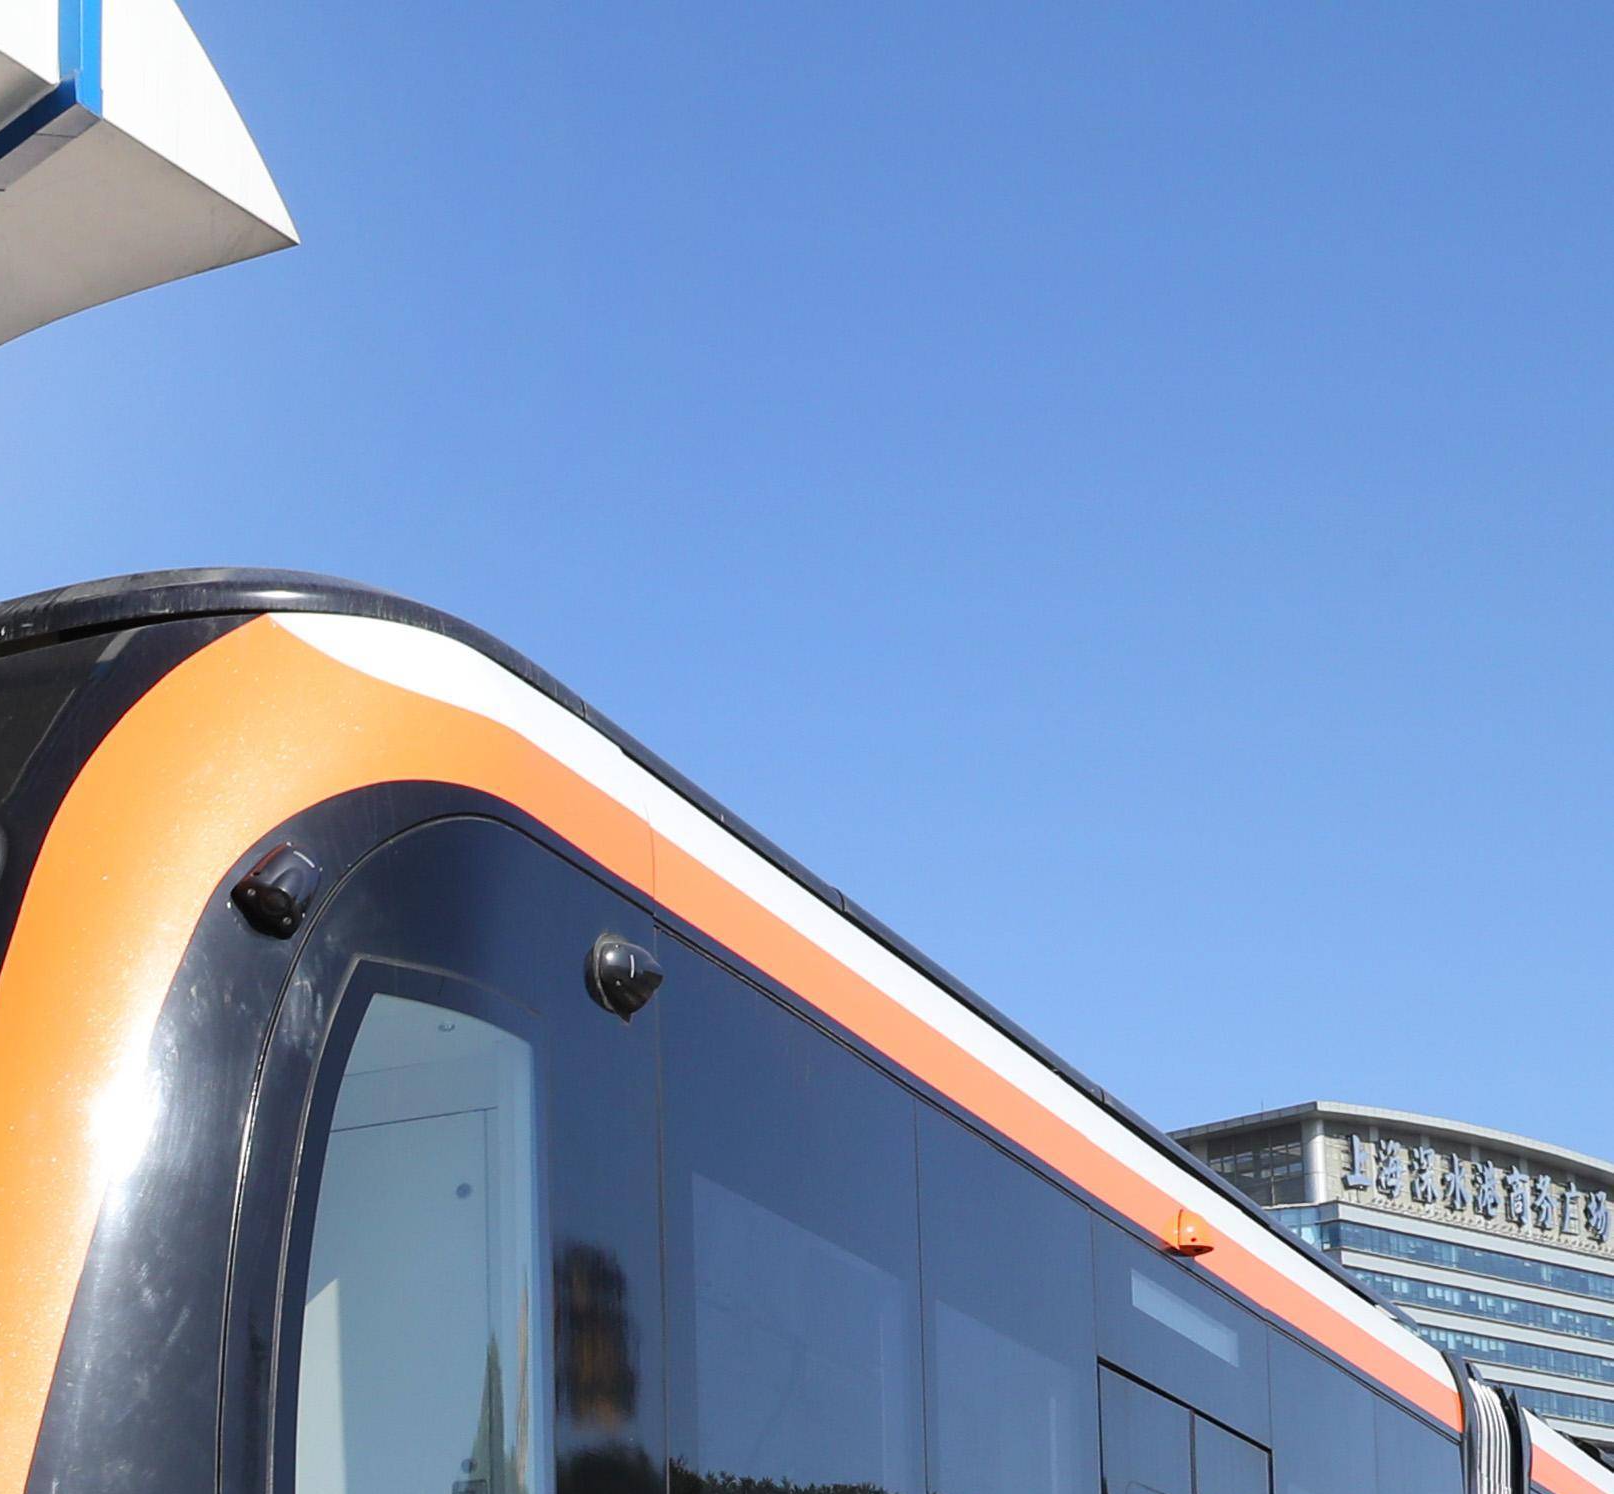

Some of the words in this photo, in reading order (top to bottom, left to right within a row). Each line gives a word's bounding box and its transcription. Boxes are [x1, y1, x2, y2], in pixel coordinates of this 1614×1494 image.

[1340, 1134, 1609, 1243] 上海深水港商务广场
